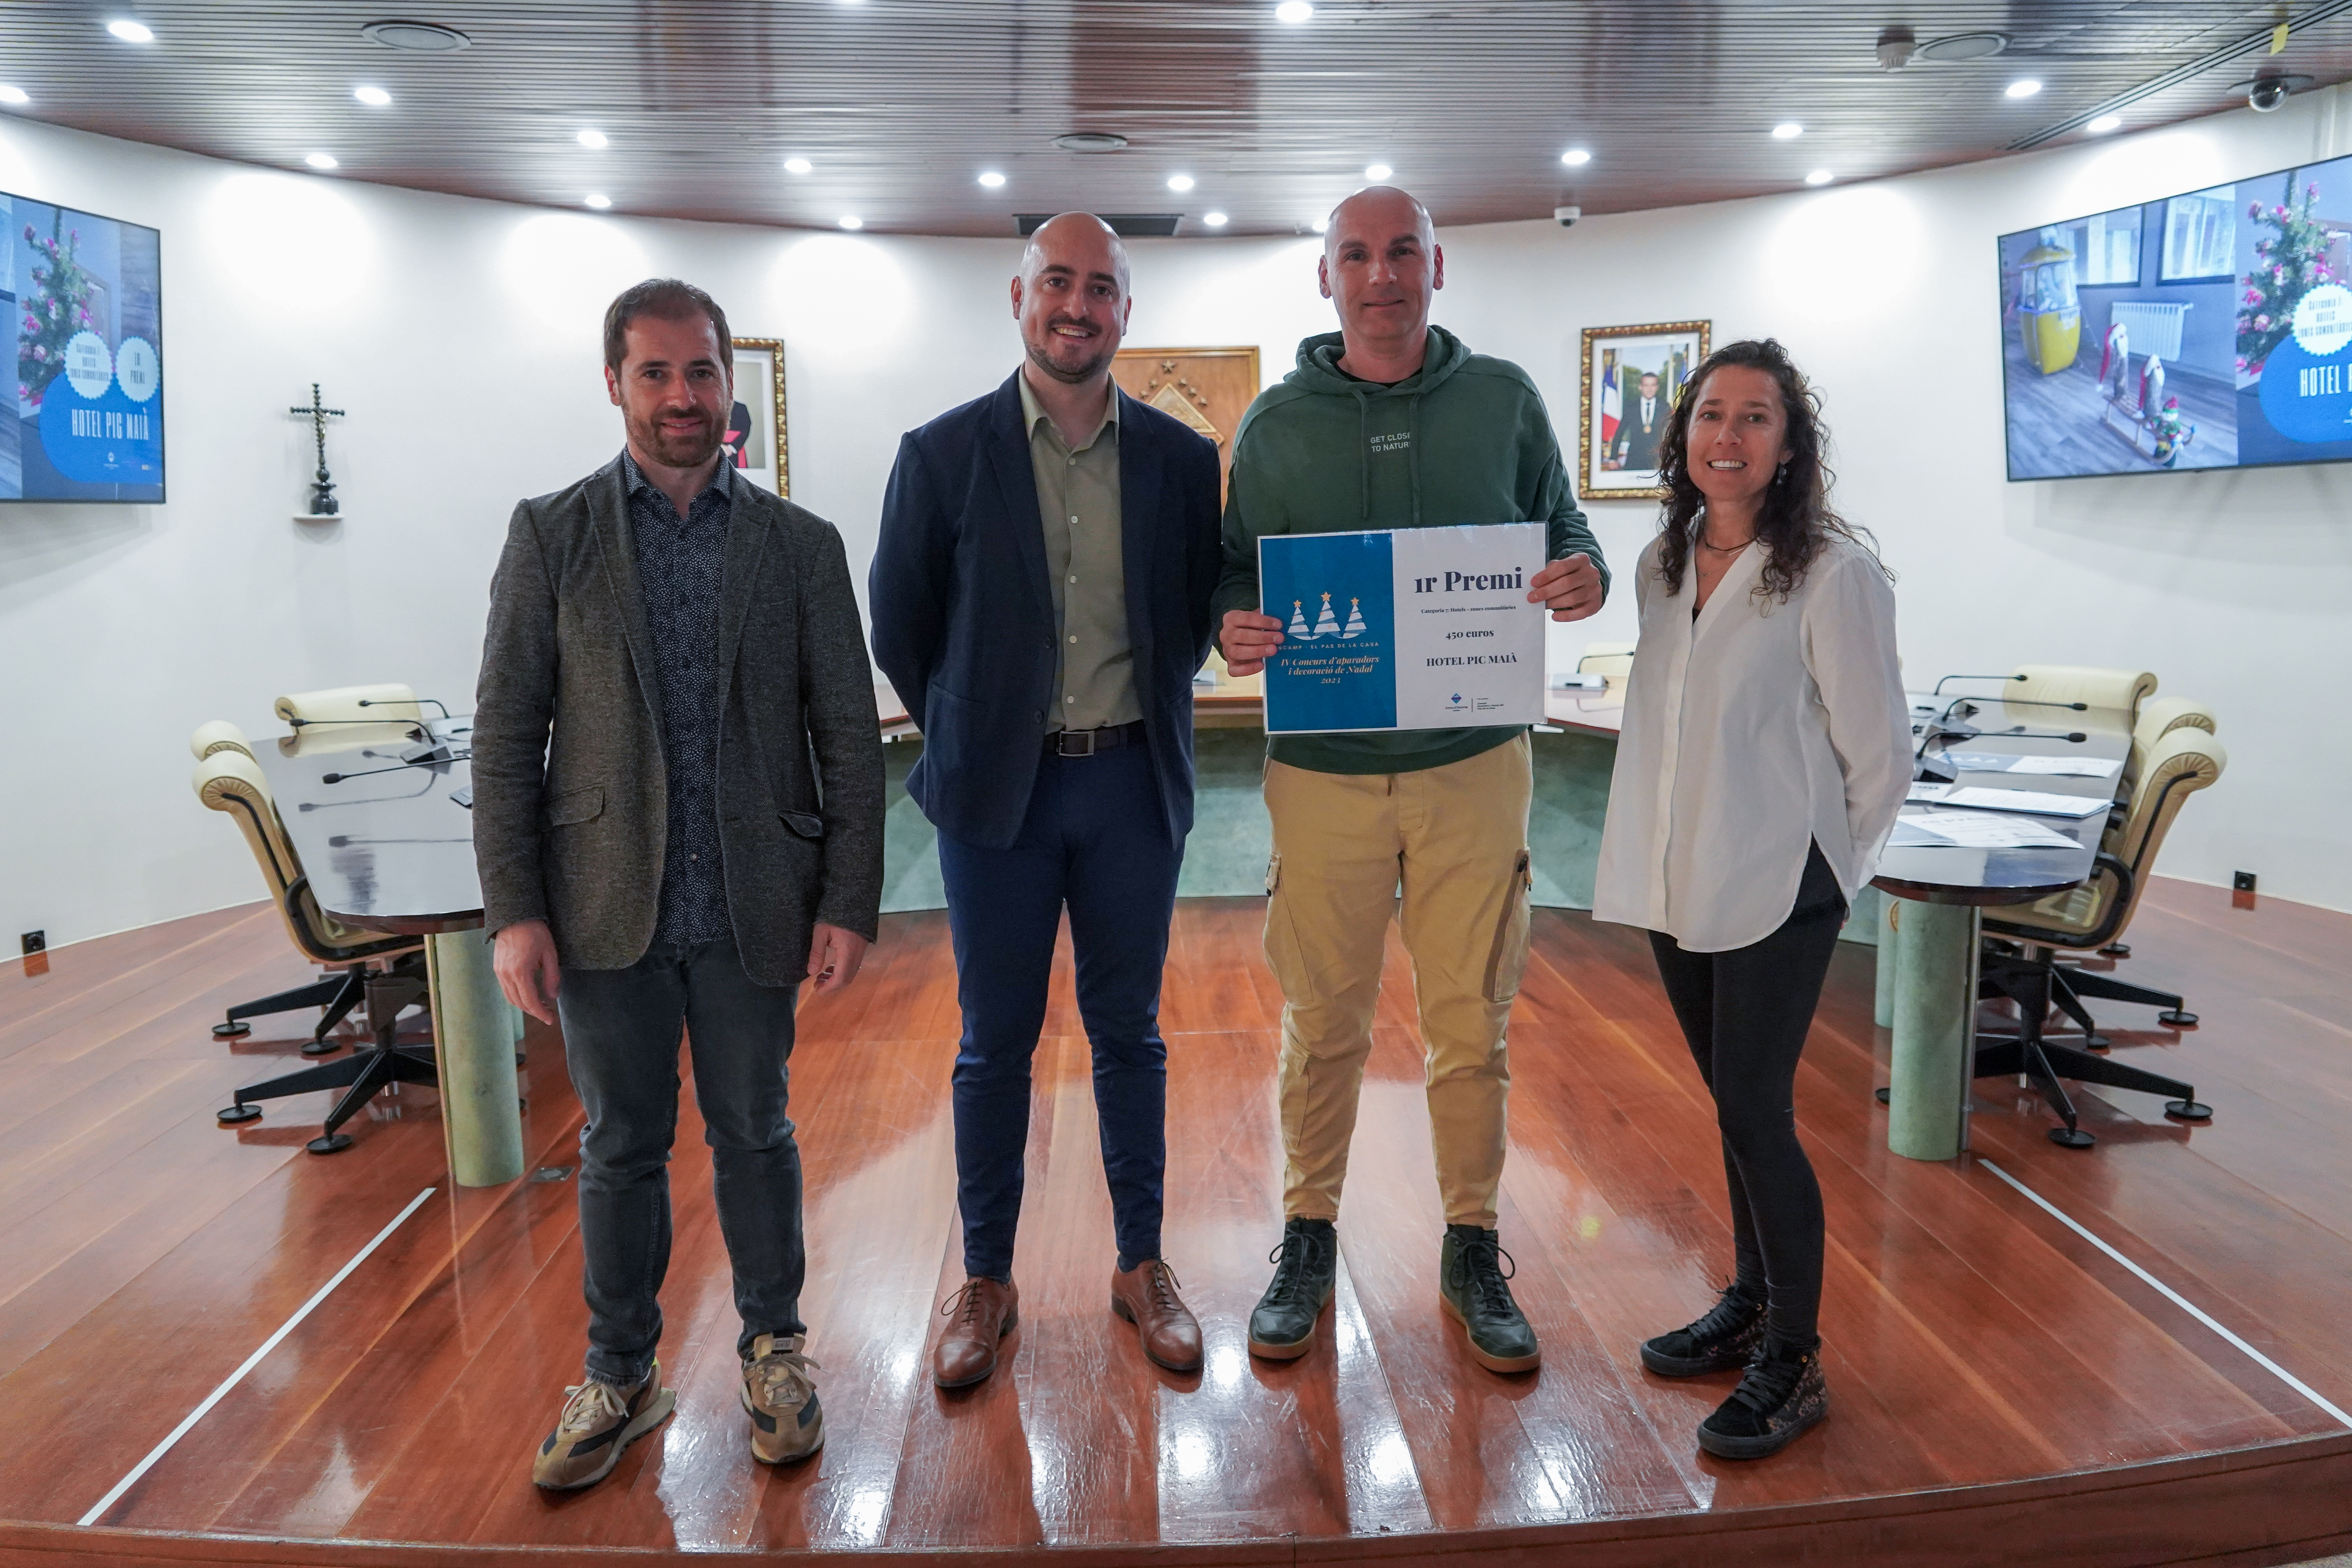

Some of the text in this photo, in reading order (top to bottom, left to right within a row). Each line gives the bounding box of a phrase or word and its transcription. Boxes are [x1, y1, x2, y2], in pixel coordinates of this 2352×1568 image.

[2300, 365, 2341, 397] HOTEL
[72, 408, 102, 437] HOTEL
[1414, 566, 1523, 593] 1r Premi
[1446, 632, 1463, 640] 450
[1426, 652, 1517, 666] HOTEL PIC MAIÀ
[1294, 666, 1334, 675] decoració
[1346, 665, 1373, 674] Nadal
